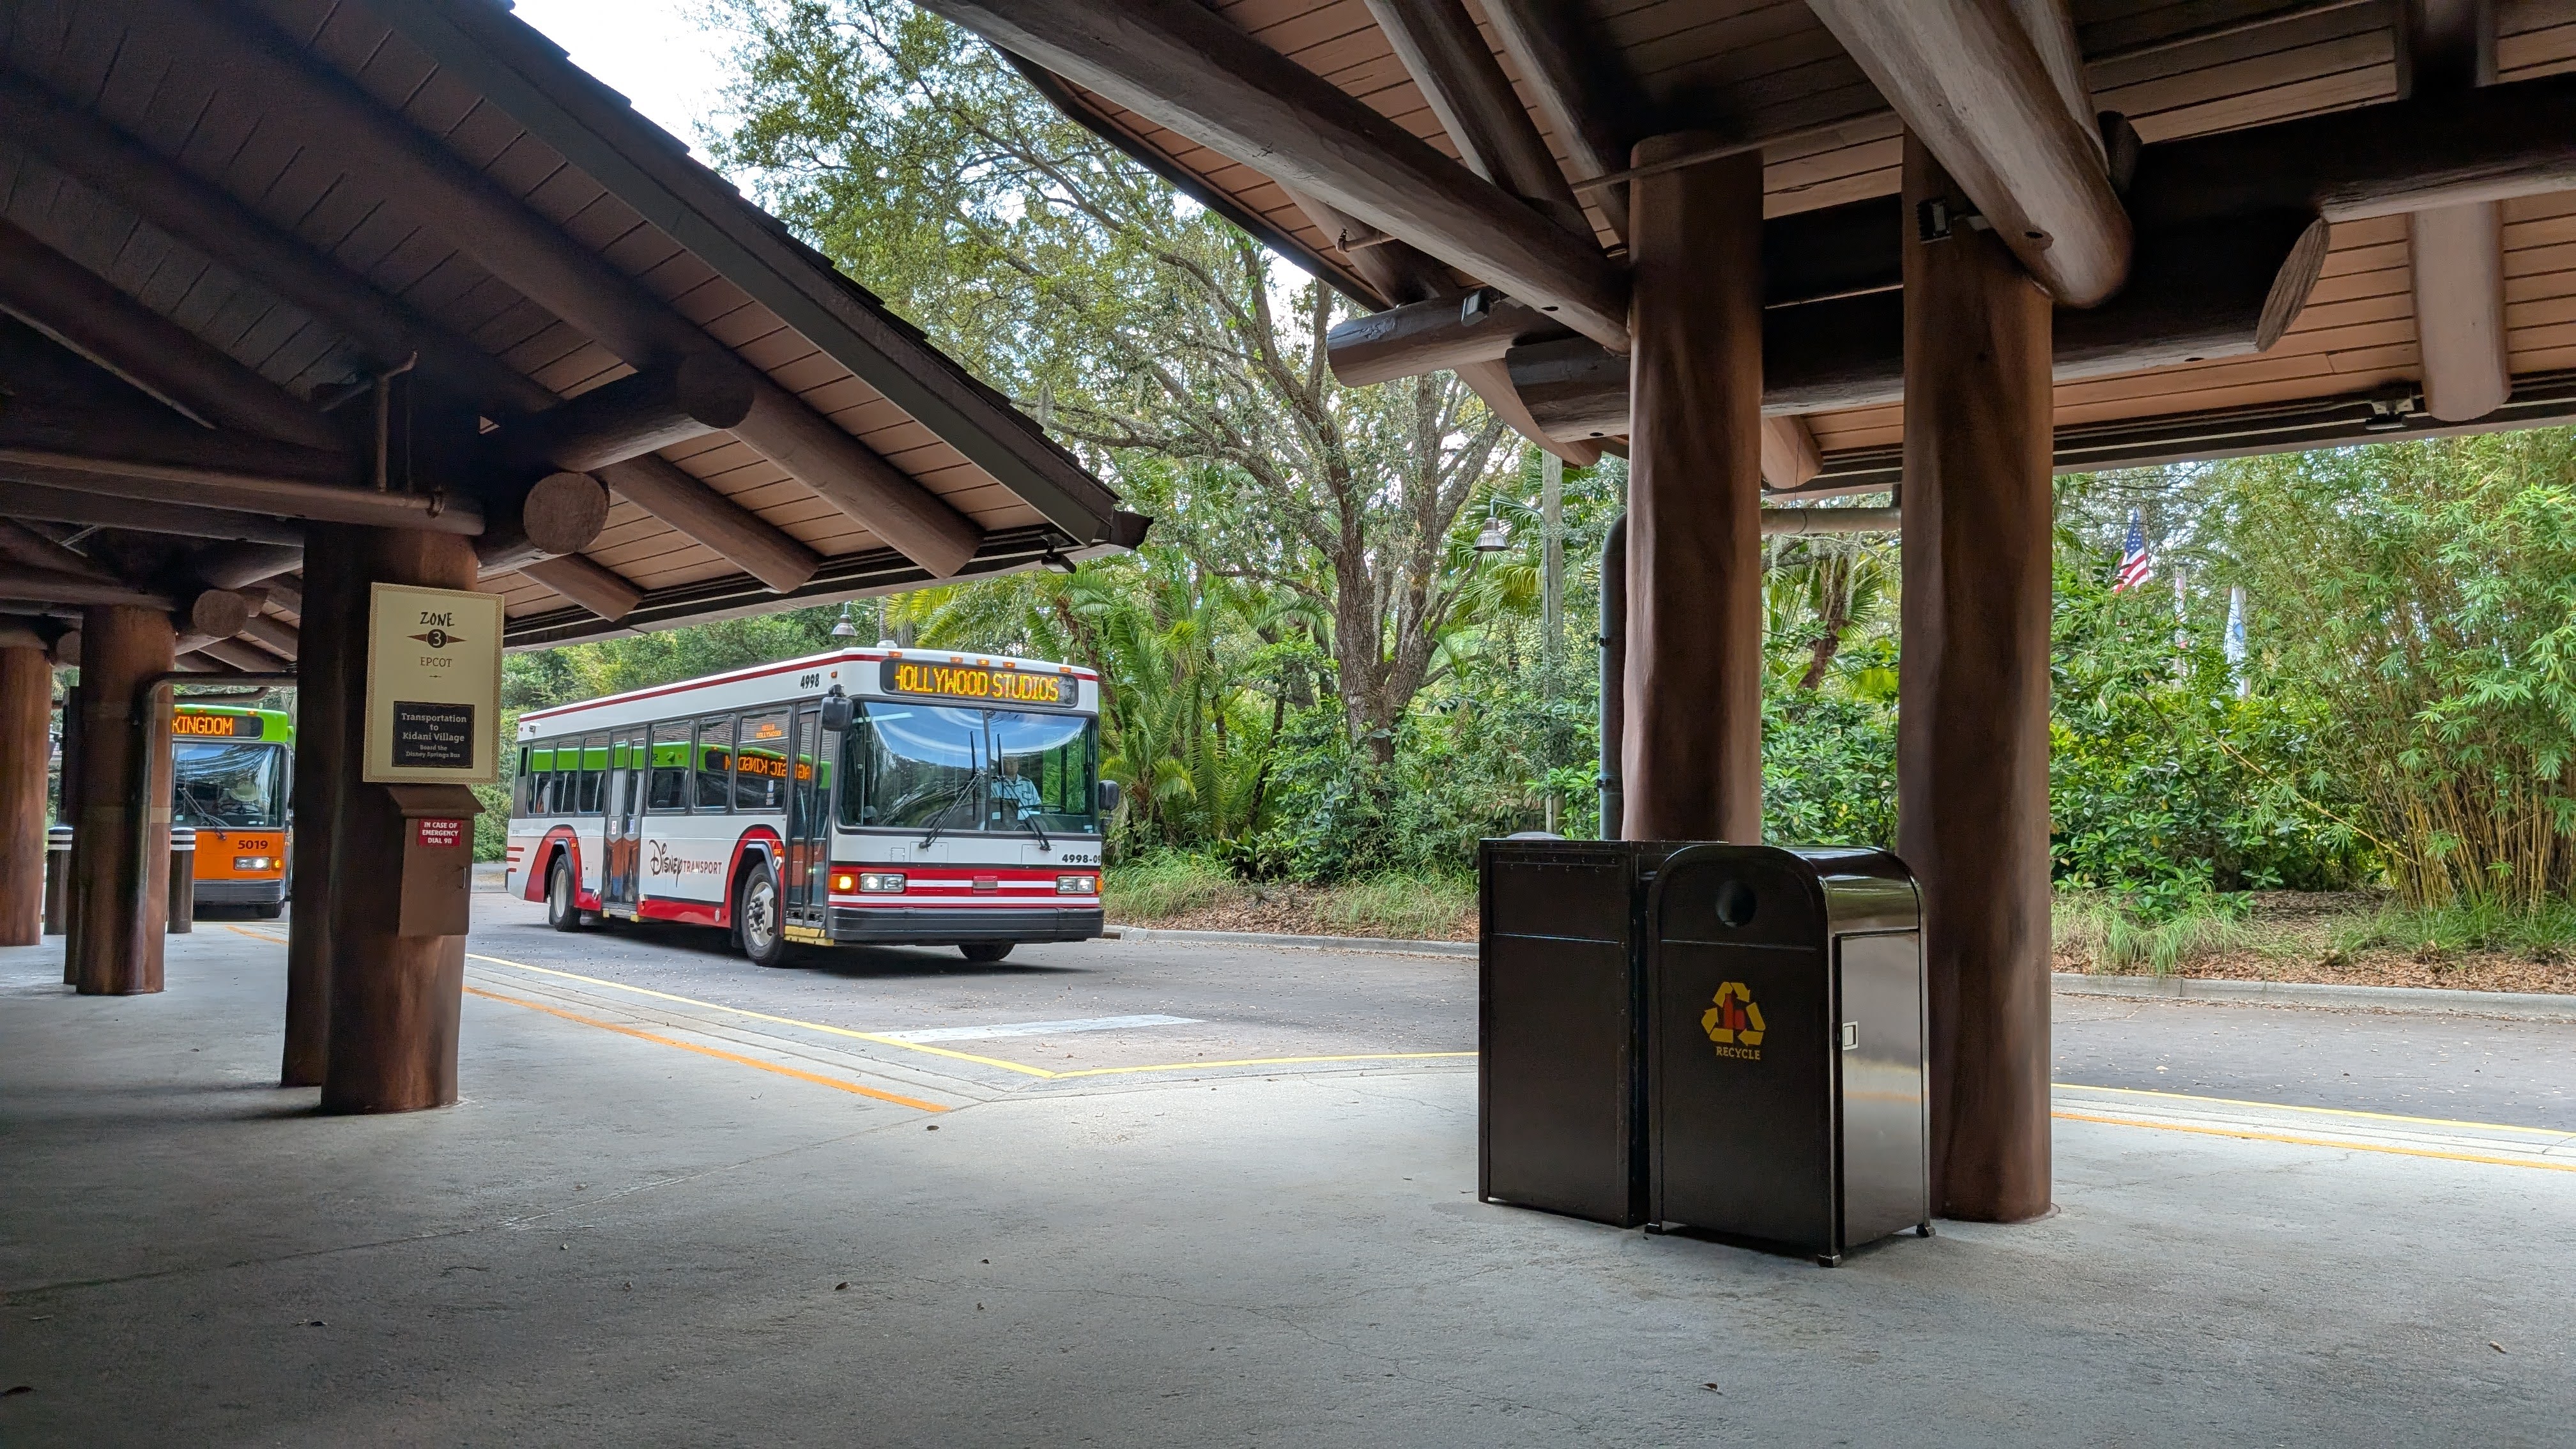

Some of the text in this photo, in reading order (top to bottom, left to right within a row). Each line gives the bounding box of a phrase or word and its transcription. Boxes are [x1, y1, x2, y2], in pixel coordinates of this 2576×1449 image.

[420, 611, 455, 627] ZONE
[433, 631, 441, 646] 3
[420, 657, 452, 667] EPCOT
[801, 673, 820, 689] 4998
[895, 665, 1059, 702] HOLLYWOOD STUDIOS
[172, 716, 233, 735] KINGDOM
[401, 713, 467, 723] Transportation
[402, 732, 465, 743] Kidani Village
[237, 839, 268, 850] 5019
[1061, 854, 1101, 864] 4998-09
[683, 860, 723, 875] TRANSPORT
[1716, 1046, 1761, 1061] RECYCLE
